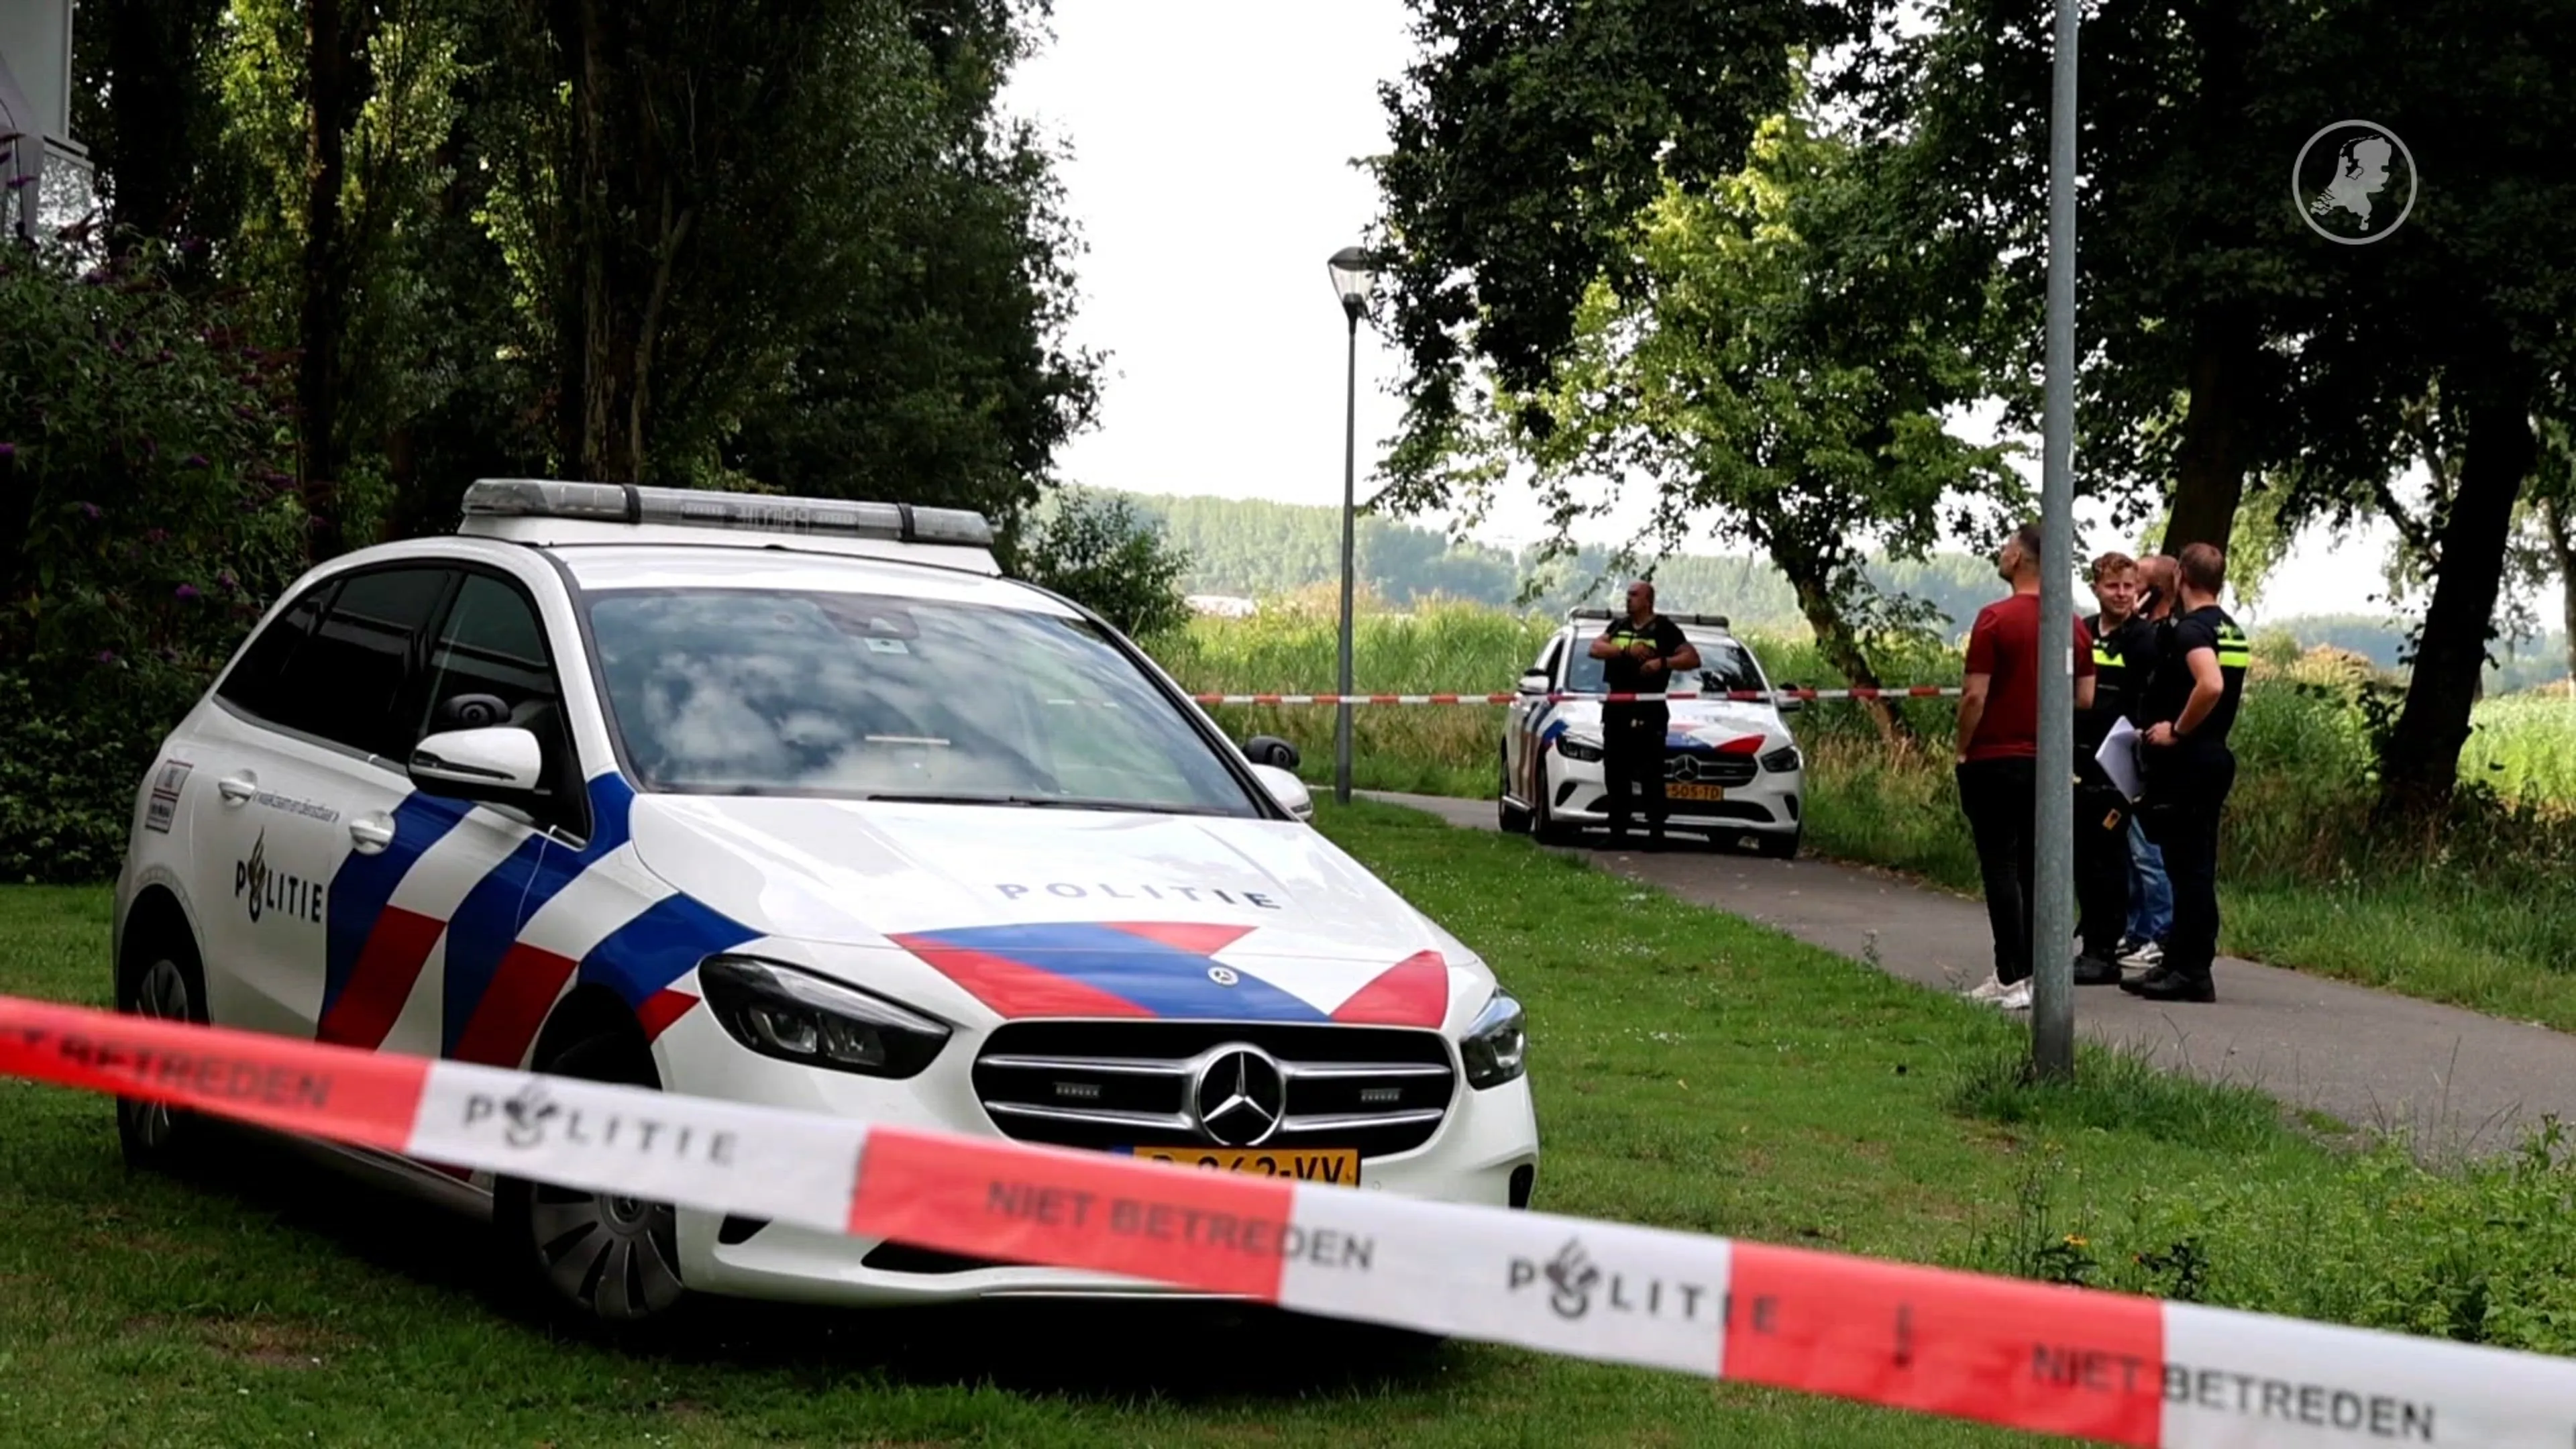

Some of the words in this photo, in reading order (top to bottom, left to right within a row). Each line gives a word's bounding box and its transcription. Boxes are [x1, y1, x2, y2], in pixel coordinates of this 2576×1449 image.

[1666, 785, 1719, 800] -505-TD
[235, 847, 323, 923] POLITIE
[996, 883, 1282, 910] POLITIE
[464, 1081, 740, 1165] POLITIE
[986, 1181, 1098, 1227] NIET
[1110, 1198, 1375, 1270] BETREDEN
[1509, 1241, 1780, 1334] POLITIE
[2032, 1343, 2141, 1393] NIET
[2161, 1365, 2436, 1441] BETREDEN
